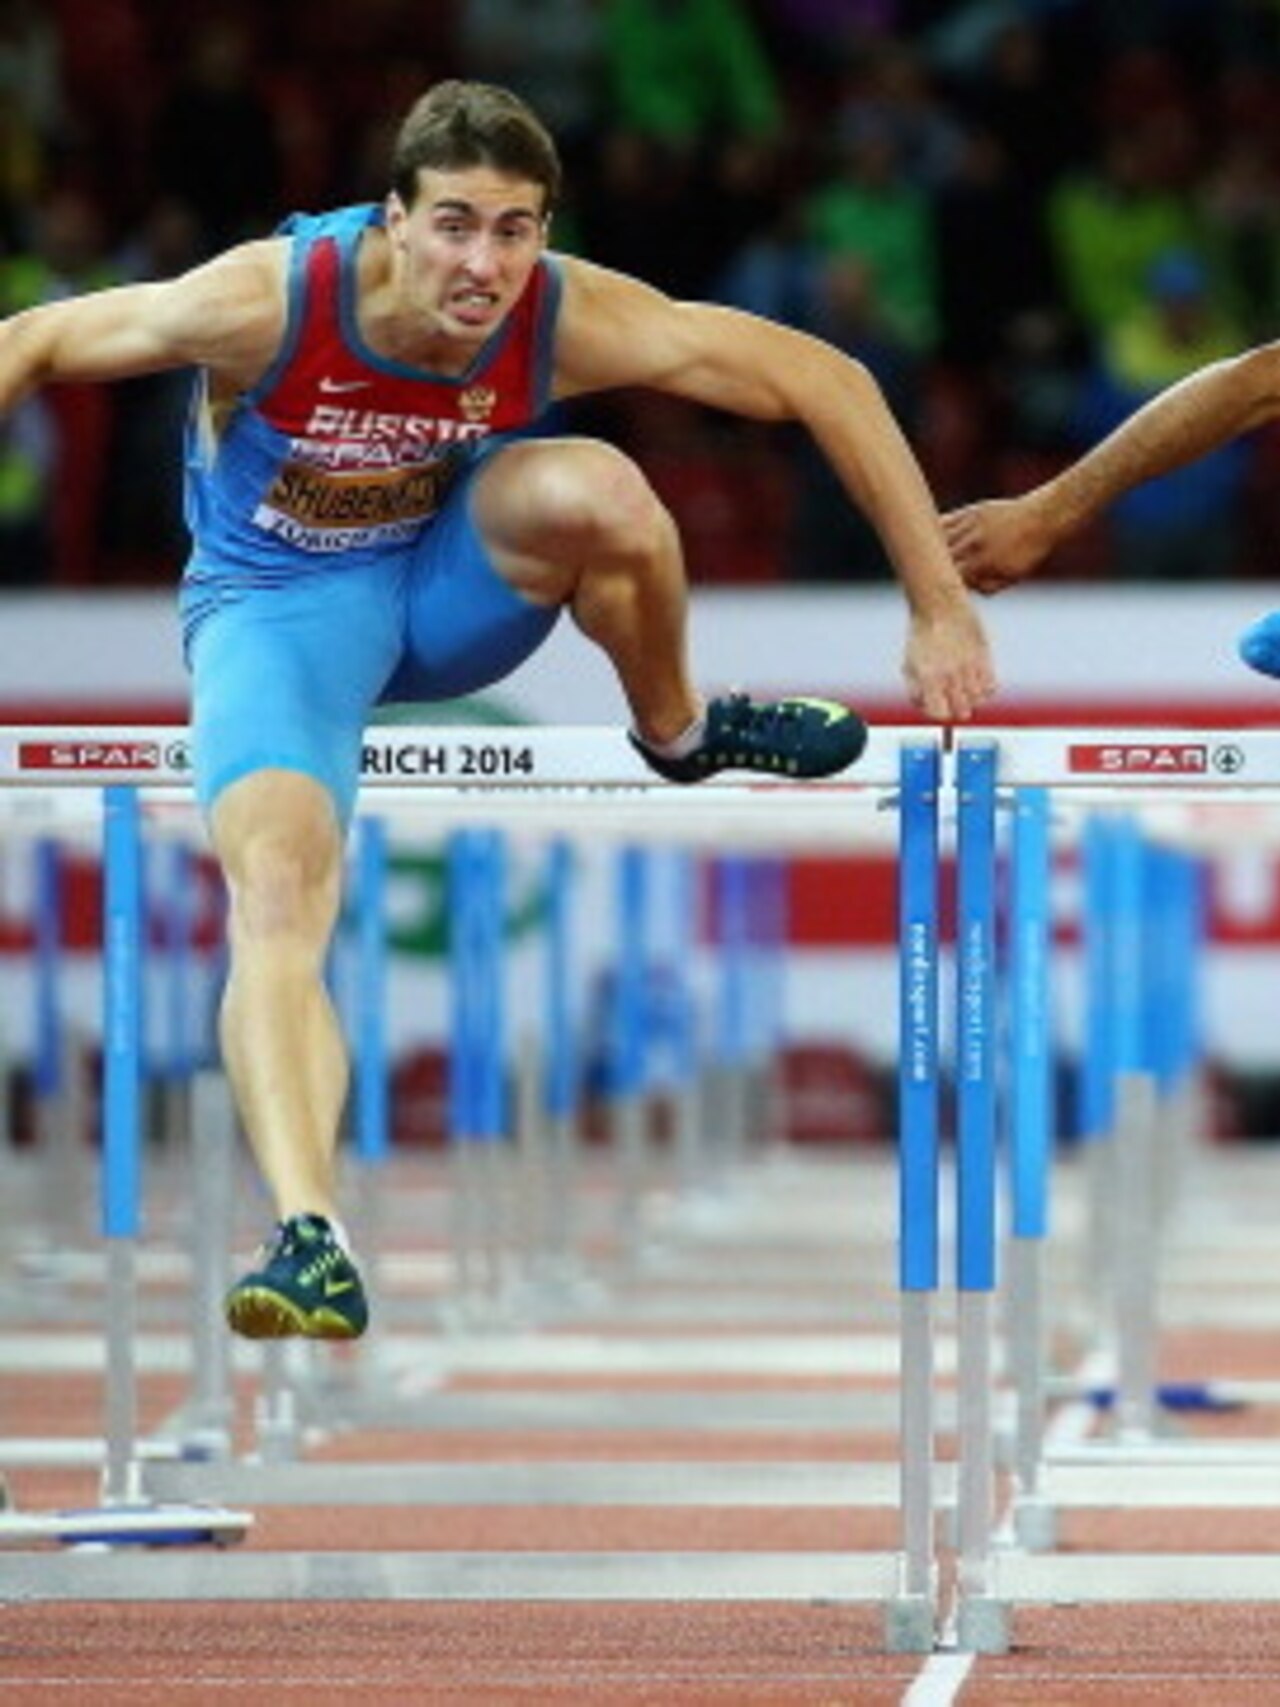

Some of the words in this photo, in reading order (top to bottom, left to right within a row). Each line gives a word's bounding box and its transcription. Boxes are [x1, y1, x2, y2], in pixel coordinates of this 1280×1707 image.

[50, 746, 158, 767] SPAR
[361, 747, 446, 774] RICH
[460, 746, 534, 774] 2014
[1099, 748, 1206, 769] SPAR
